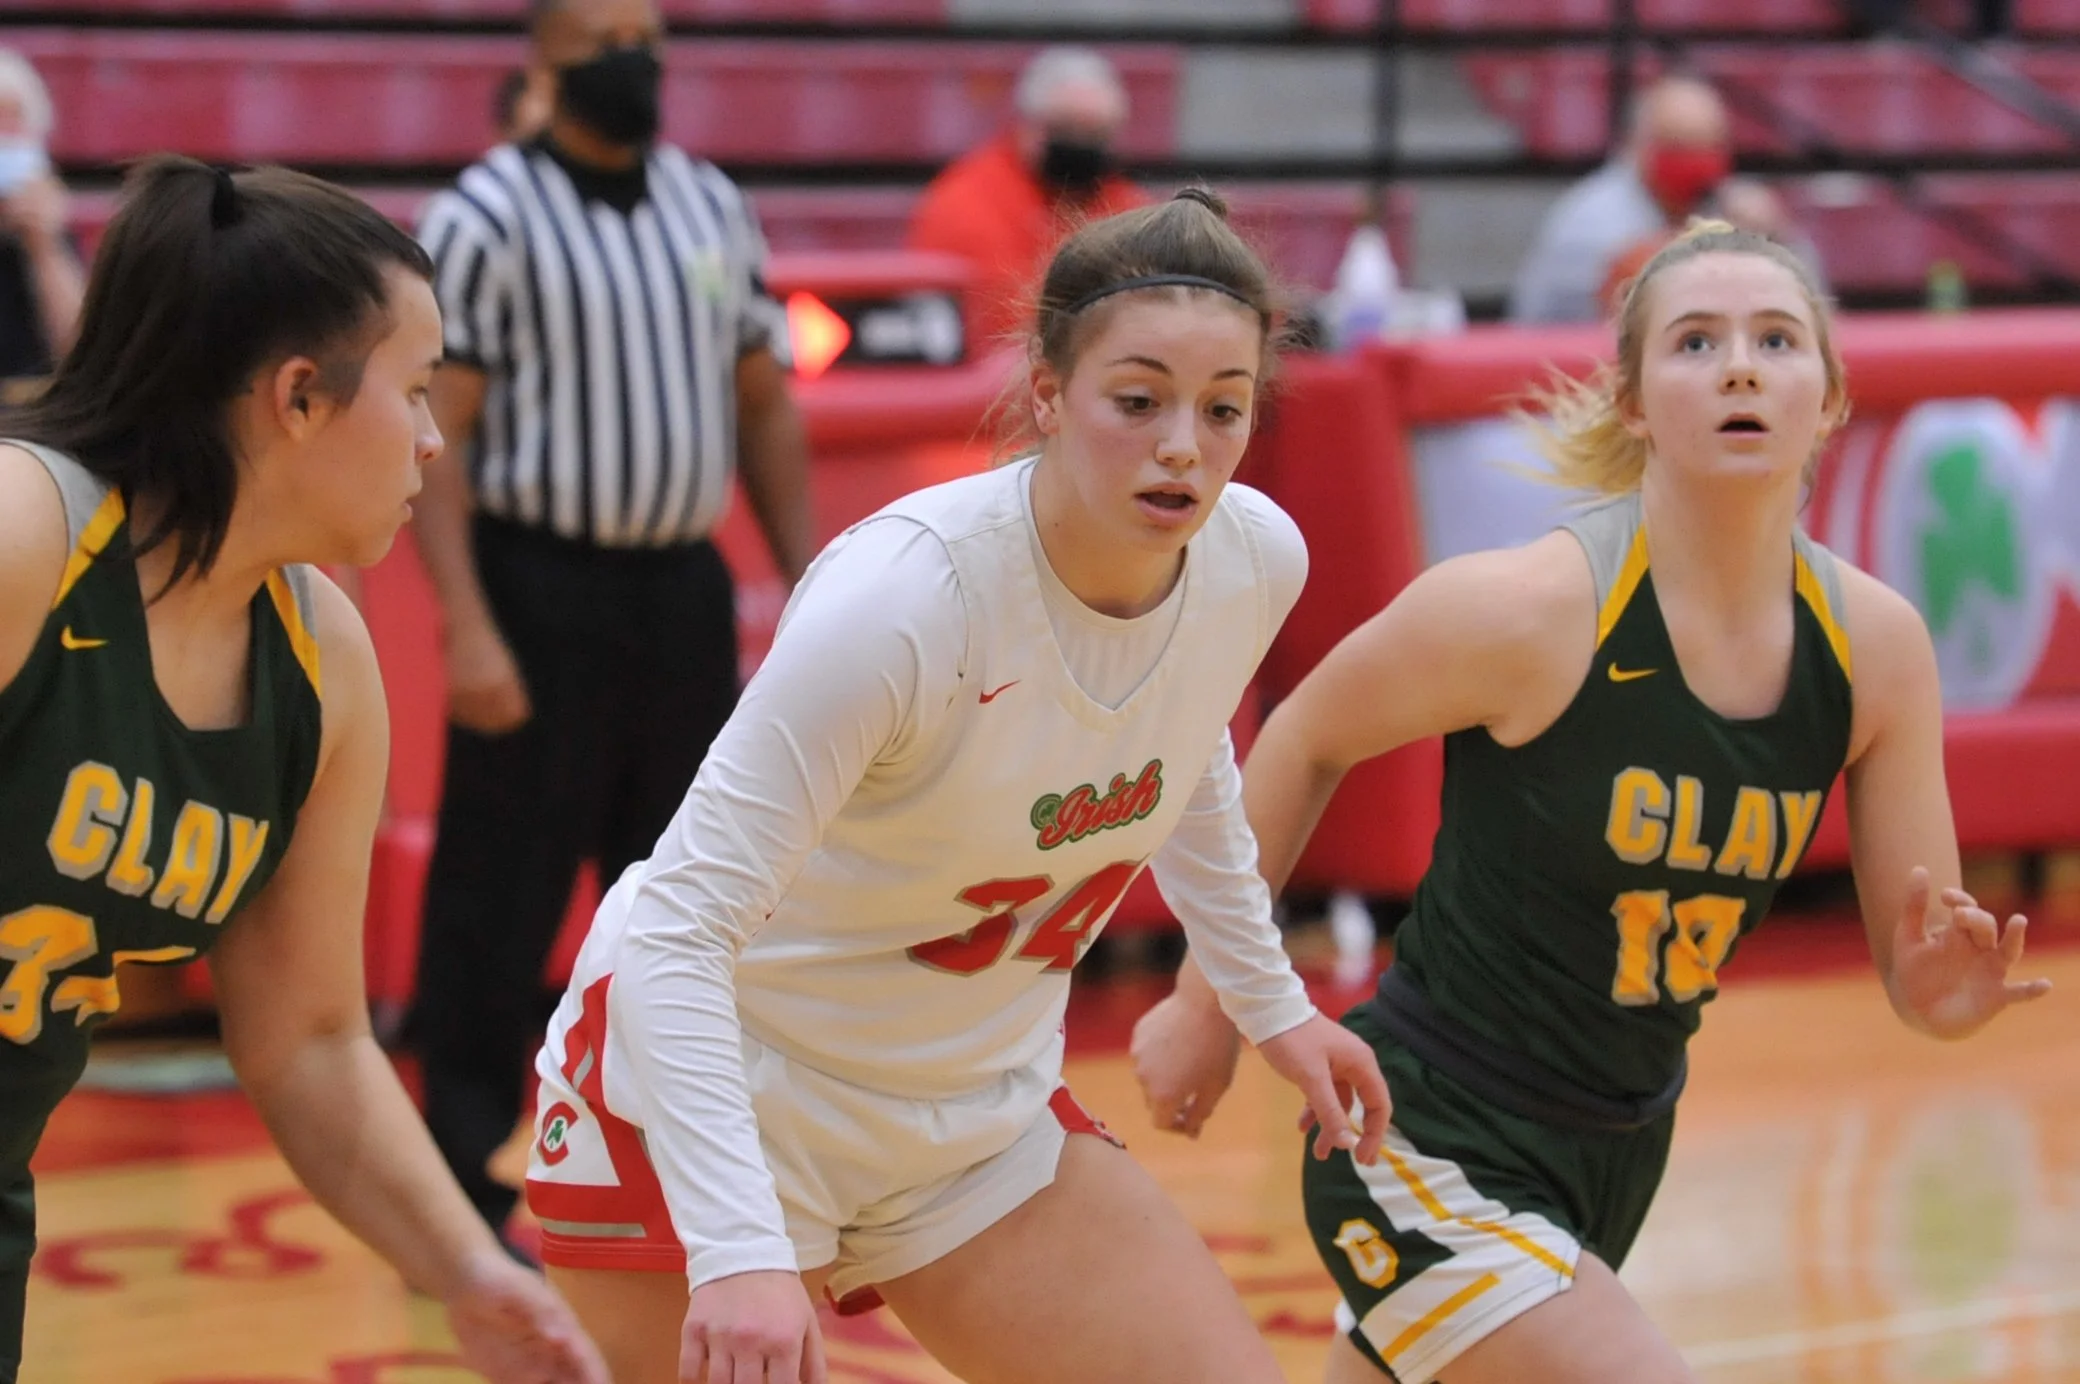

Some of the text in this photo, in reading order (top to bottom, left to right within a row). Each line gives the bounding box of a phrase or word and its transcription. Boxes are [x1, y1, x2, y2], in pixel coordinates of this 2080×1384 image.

[46, 760, 270, 925] CLAY
[1036, 758, 1163, 851] Irish
[1604, 766, 1822, 880] CLAY
[904, 857, 1150, 978] 34
